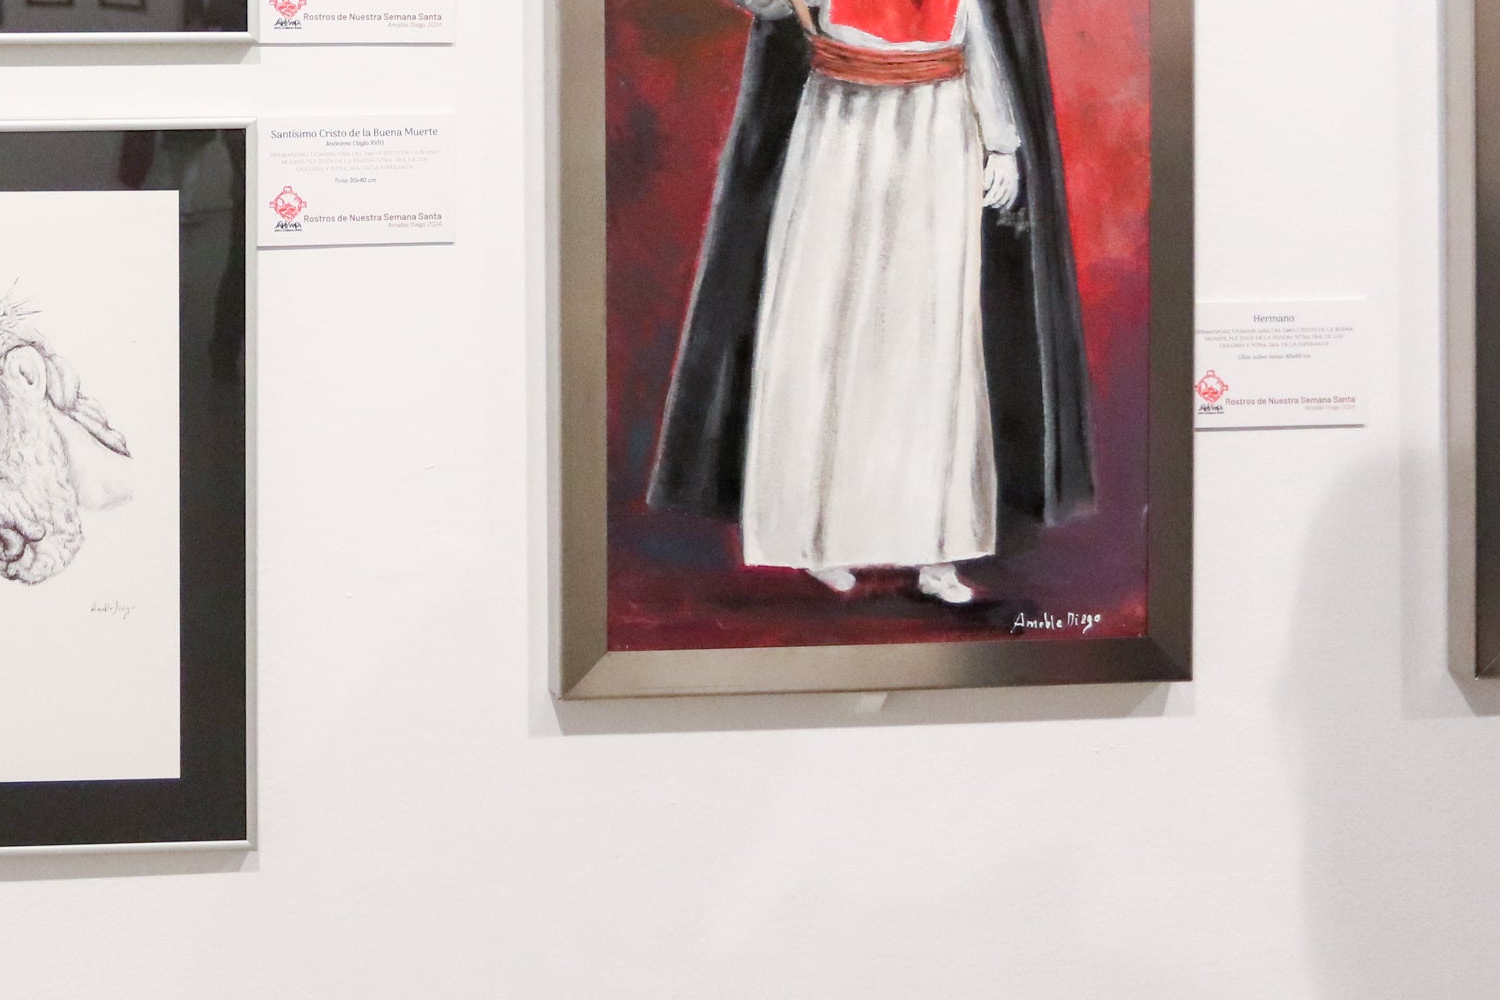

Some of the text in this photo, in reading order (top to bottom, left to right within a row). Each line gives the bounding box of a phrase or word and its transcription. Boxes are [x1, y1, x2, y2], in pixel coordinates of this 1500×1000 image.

[303, 13, 442, 21] Rostros de Nuestra Semana Santa
[271, 127, 438, 139] Santísimo Cristo de la Buena Muerte
[303, 213, 442, 223] Rostros de Nuestra Semana Santa
[1253, 314, 1295, 323] Hermano
[1225, 397, 1256, 406] Rostros
[1268, 397, 1299, 405] Nuestra
[1300, 396, 1332, 404] Semana
[1333, 396, 1356, 404] Santa
